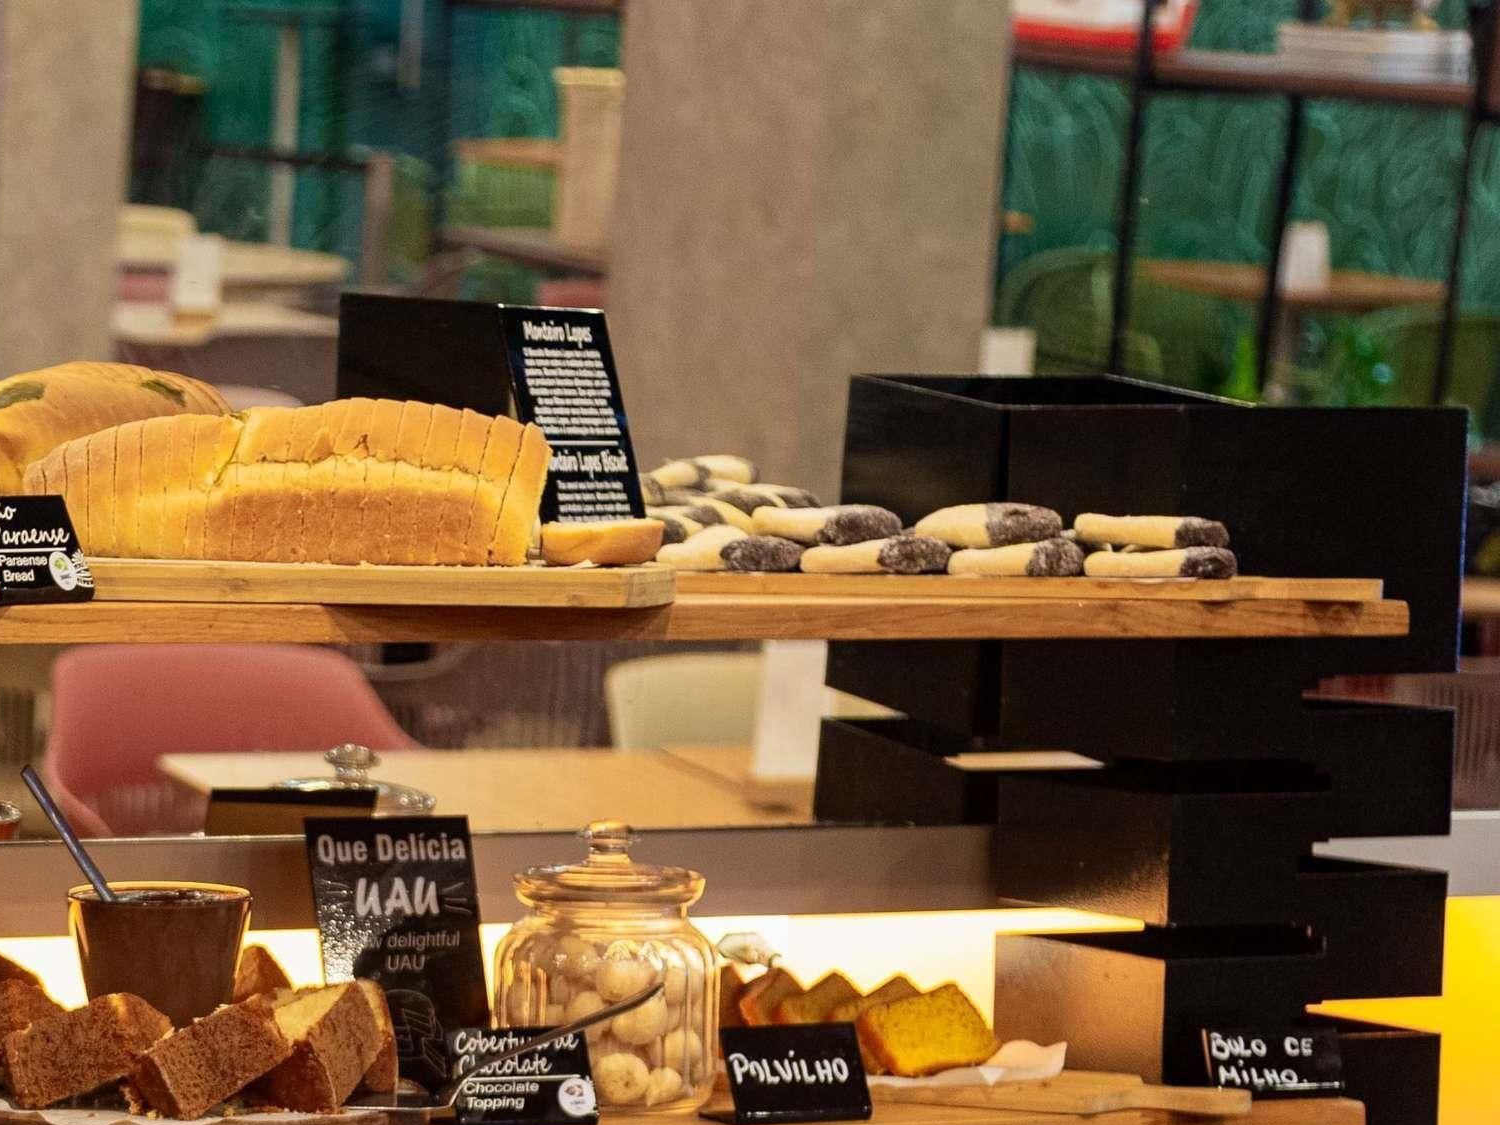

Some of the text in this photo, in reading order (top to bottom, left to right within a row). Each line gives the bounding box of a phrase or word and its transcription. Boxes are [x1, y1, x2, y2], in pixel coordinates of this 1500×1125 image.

[2, 568, 36, 583] Bread
[317, 832, 468, 866] Que Delícia
[355, 876, 440, 917] UAU
[387, 930, 461, 951] delightful
[386, 954, 427, 971] UAU
[463, 1081, 540, 1095] Chocolate
[466, 1095, 525, 1111] Topping
